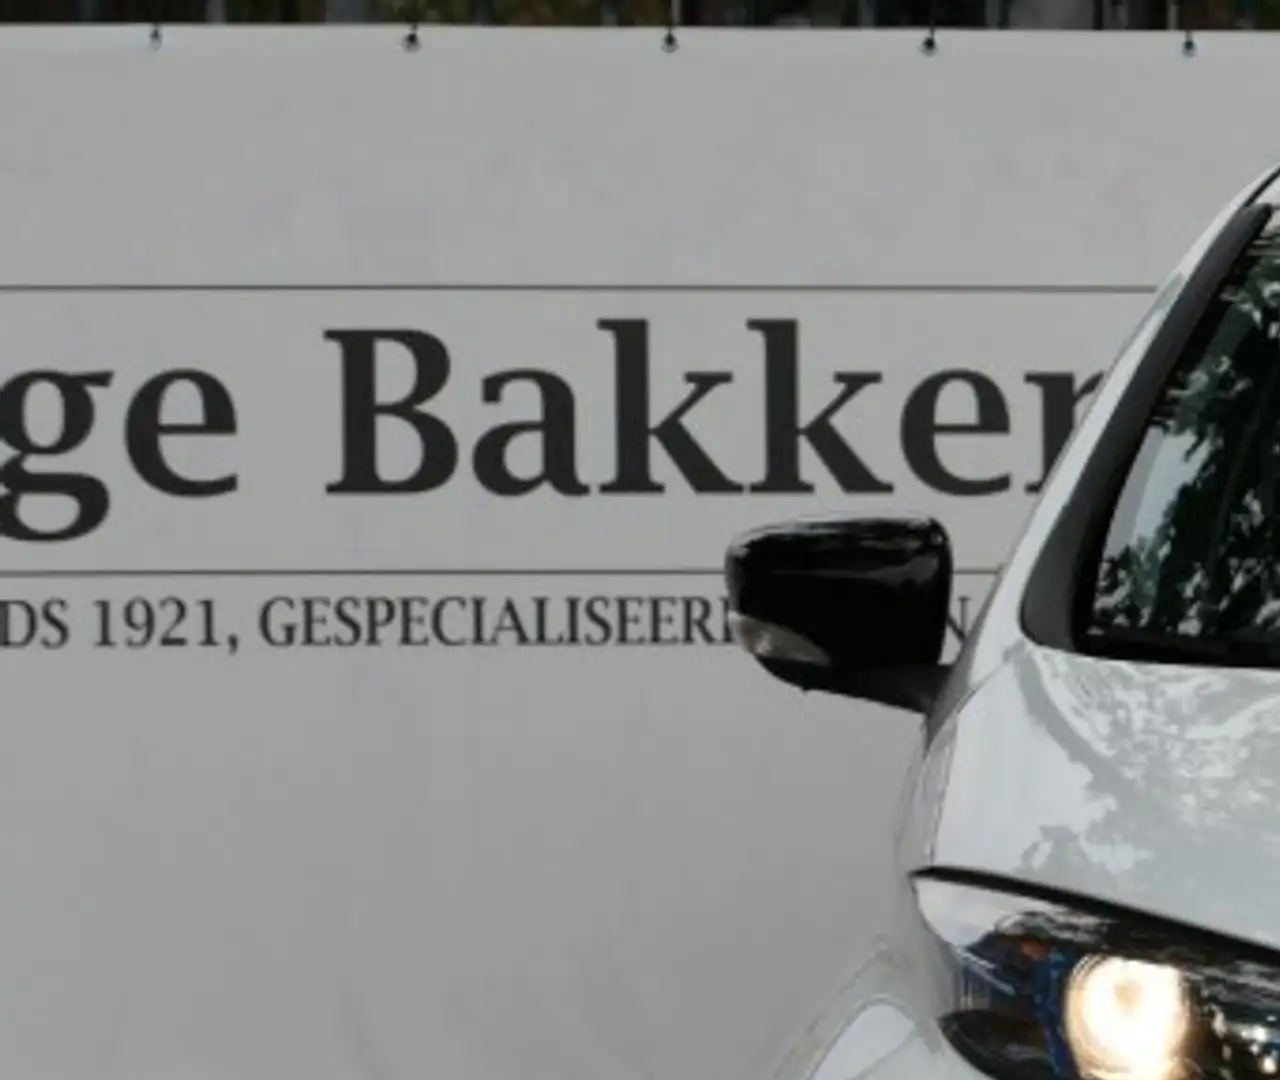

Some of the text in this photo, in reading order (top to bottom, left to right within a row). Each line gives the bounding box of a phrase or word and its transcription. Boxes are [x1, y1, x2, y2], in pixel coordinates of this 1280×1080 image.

[323, 318, 1104, 496] Bakker
[93, 596, 239, 655] 1921,
[258, 595, 736, 648] GESPECIALISEER
